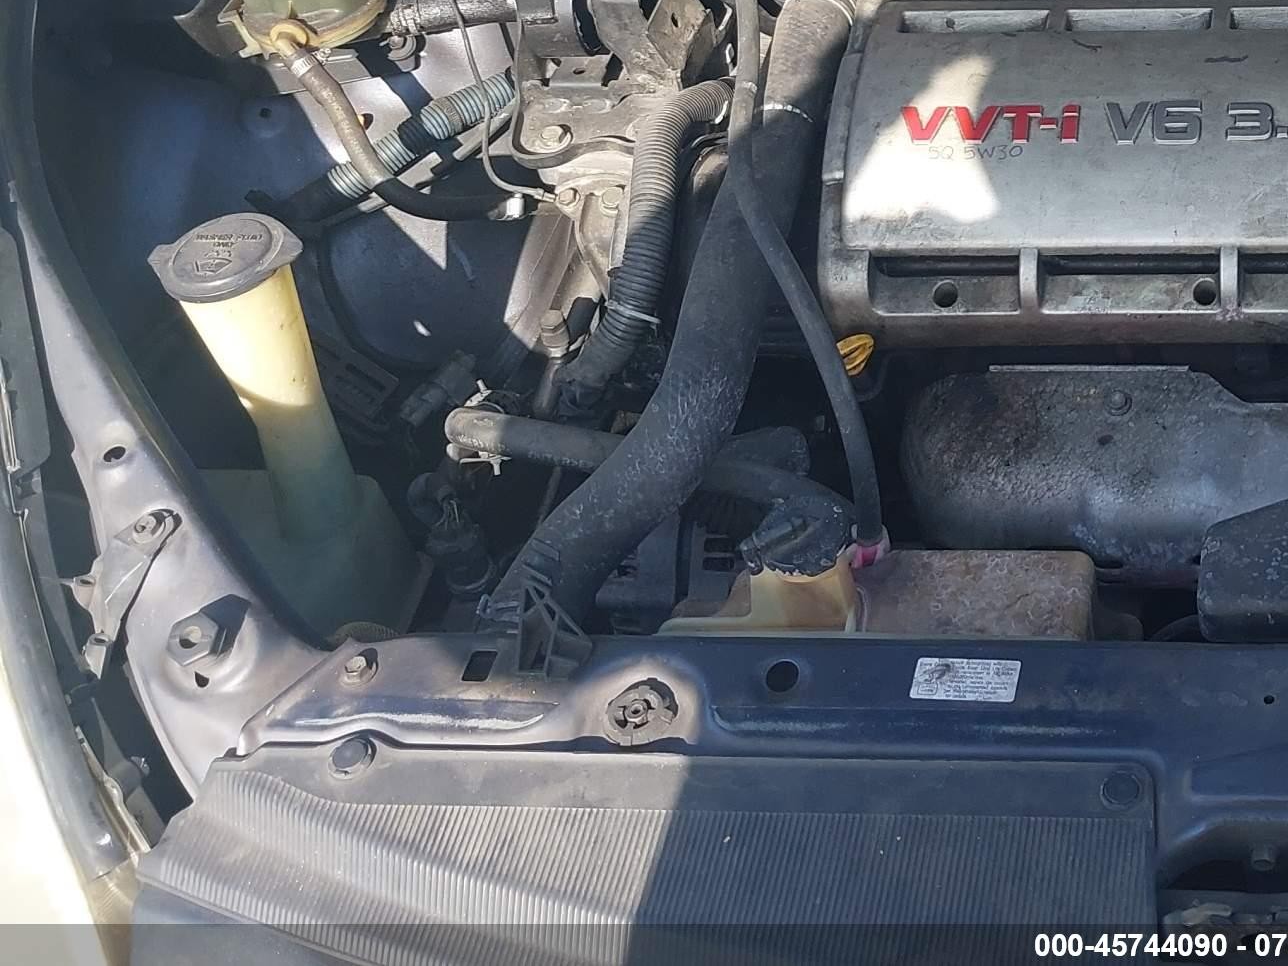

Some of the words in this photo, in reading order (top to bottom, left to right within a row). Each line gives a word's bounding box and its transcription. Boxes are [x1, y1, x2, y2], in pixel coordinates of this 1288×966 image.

[901, 104, 1082, 145] VVT-i
[1104, 100, 1203, 146] V6
[963, 144, 1024, 161] 5W30
